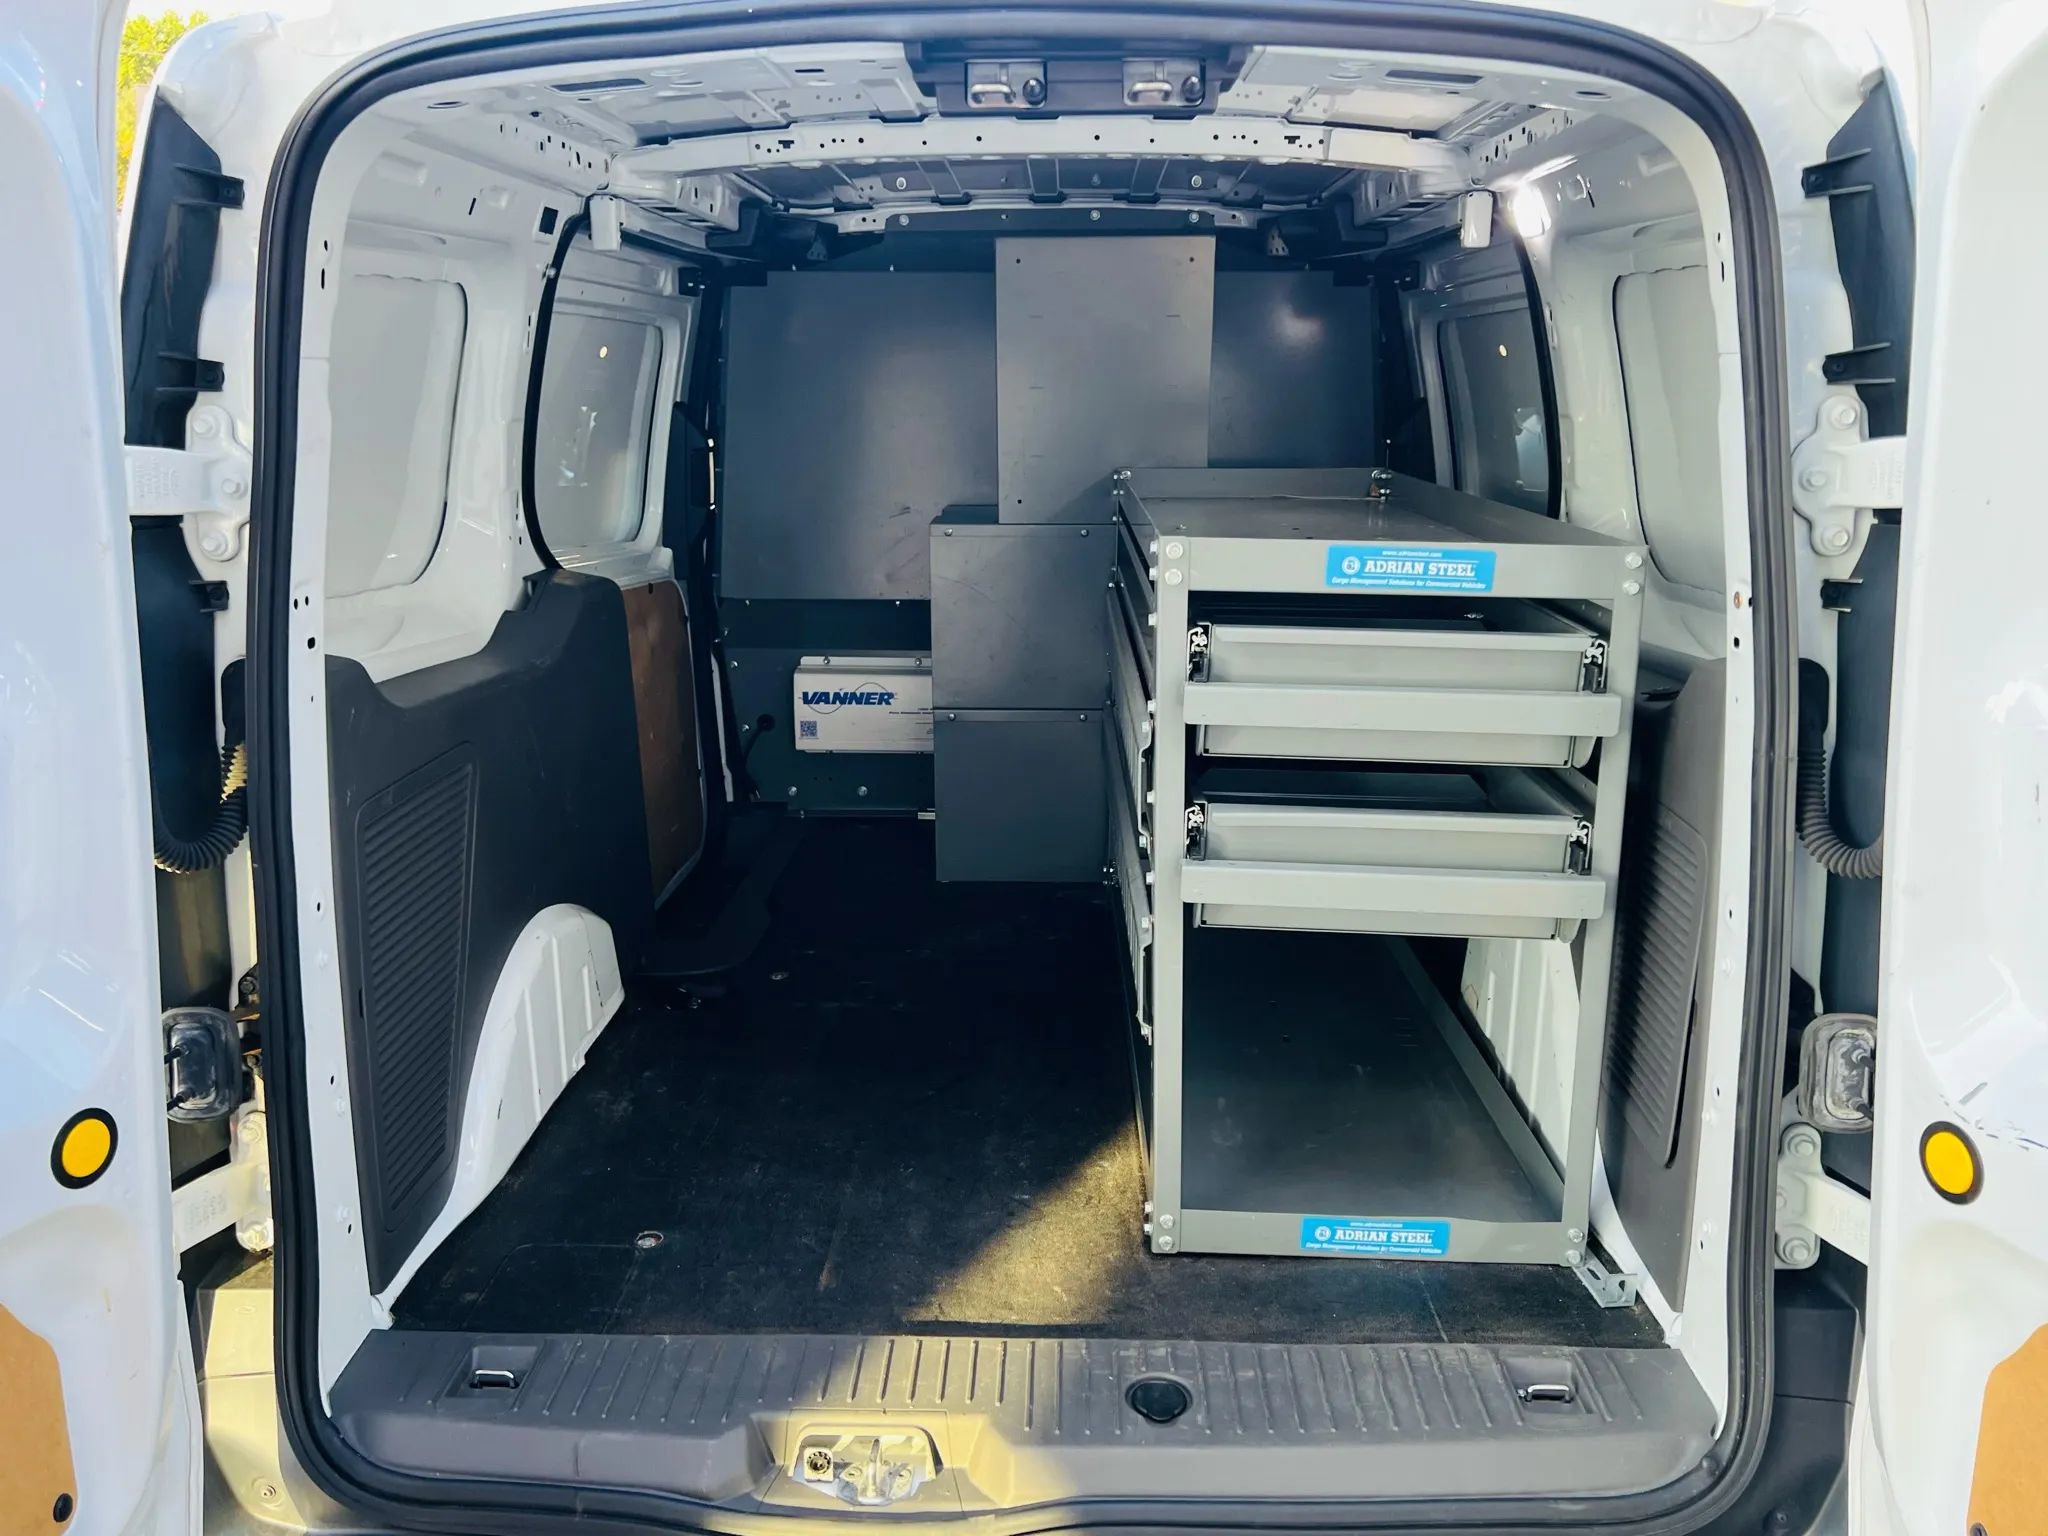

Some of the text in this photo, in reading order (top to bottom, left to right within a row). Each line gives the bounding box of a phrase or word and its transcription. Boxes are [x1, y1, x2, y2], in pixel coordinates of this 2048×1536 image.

[1364, 560, 1475, 577] ADRIAN STEEL
[1332, 577, 1349, 585] Cargo
[1350, 578, 1387, 586] Management
[802, 691, 894, 705] VANNER
[1334, 1229, 1433, 1244] ADRIAN STEEL
